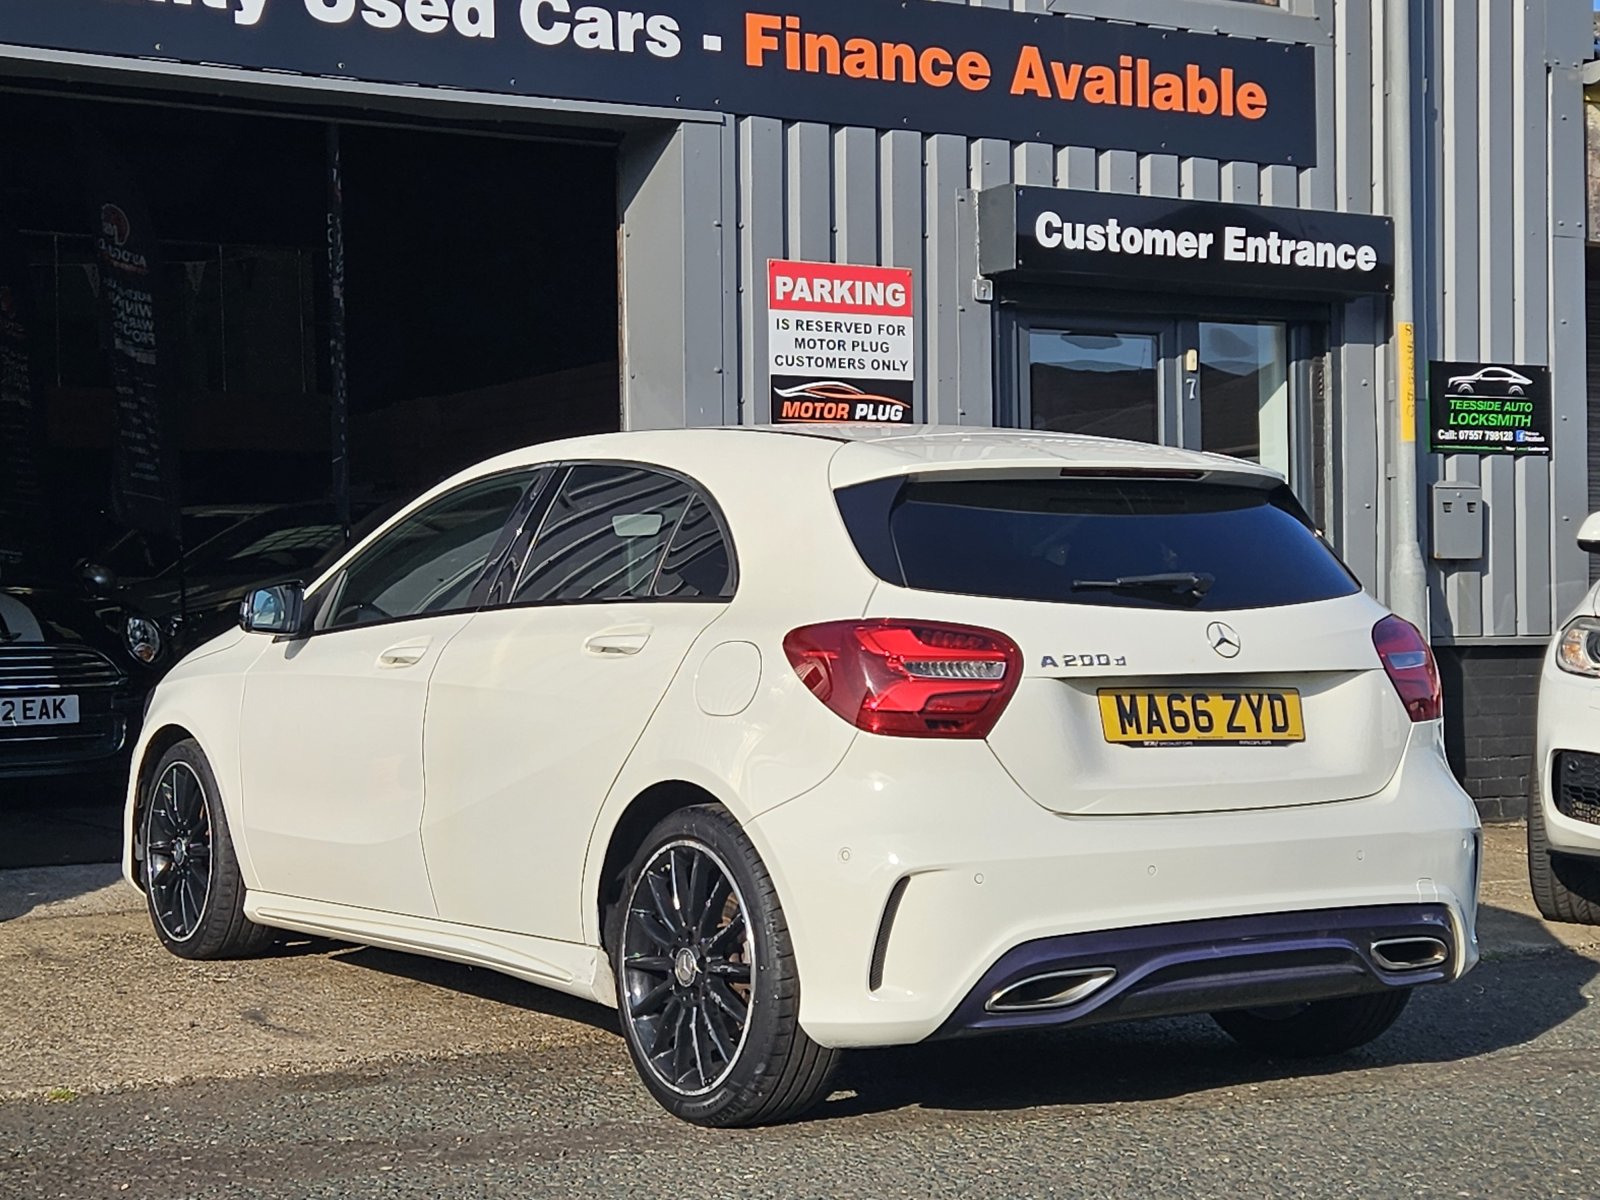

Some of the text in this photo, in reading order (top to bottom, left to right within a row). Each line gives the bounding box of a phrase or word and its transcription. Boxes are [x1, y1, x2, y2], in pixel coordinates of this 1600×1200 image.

[519, 0, 681, 58] Cars
[745, 12, 991, 91] Finance
[1010, 45, 1268, 120] Available
[1035, 211, 1378, 272] Customer Entrance
[775, 275, 906, 307] PARKING
[776, 318, 906, 336] IS RESERVED FOR
[794, 337, 890, 353] MOTOR PLUG
[774, 354, 908, 372] CUSTOMERS ONLY
[1186, 378, 1196, 400] 7
[782, 401, 904, 420] MOTOR PLUG
[1449, 399, 1533, 413] TEESSIDE AUTO
[1449, 412, 1532, 427] LOCKSMITH
[1438, 429, 1458, 440] Call:
[1458, 430, 1484, 440] 07557
[1041, 655, 1059, 668] A
[1, 698, 67, 721] 2 EAK
[1114, 693, 1290, 735] MA66 ZYD
